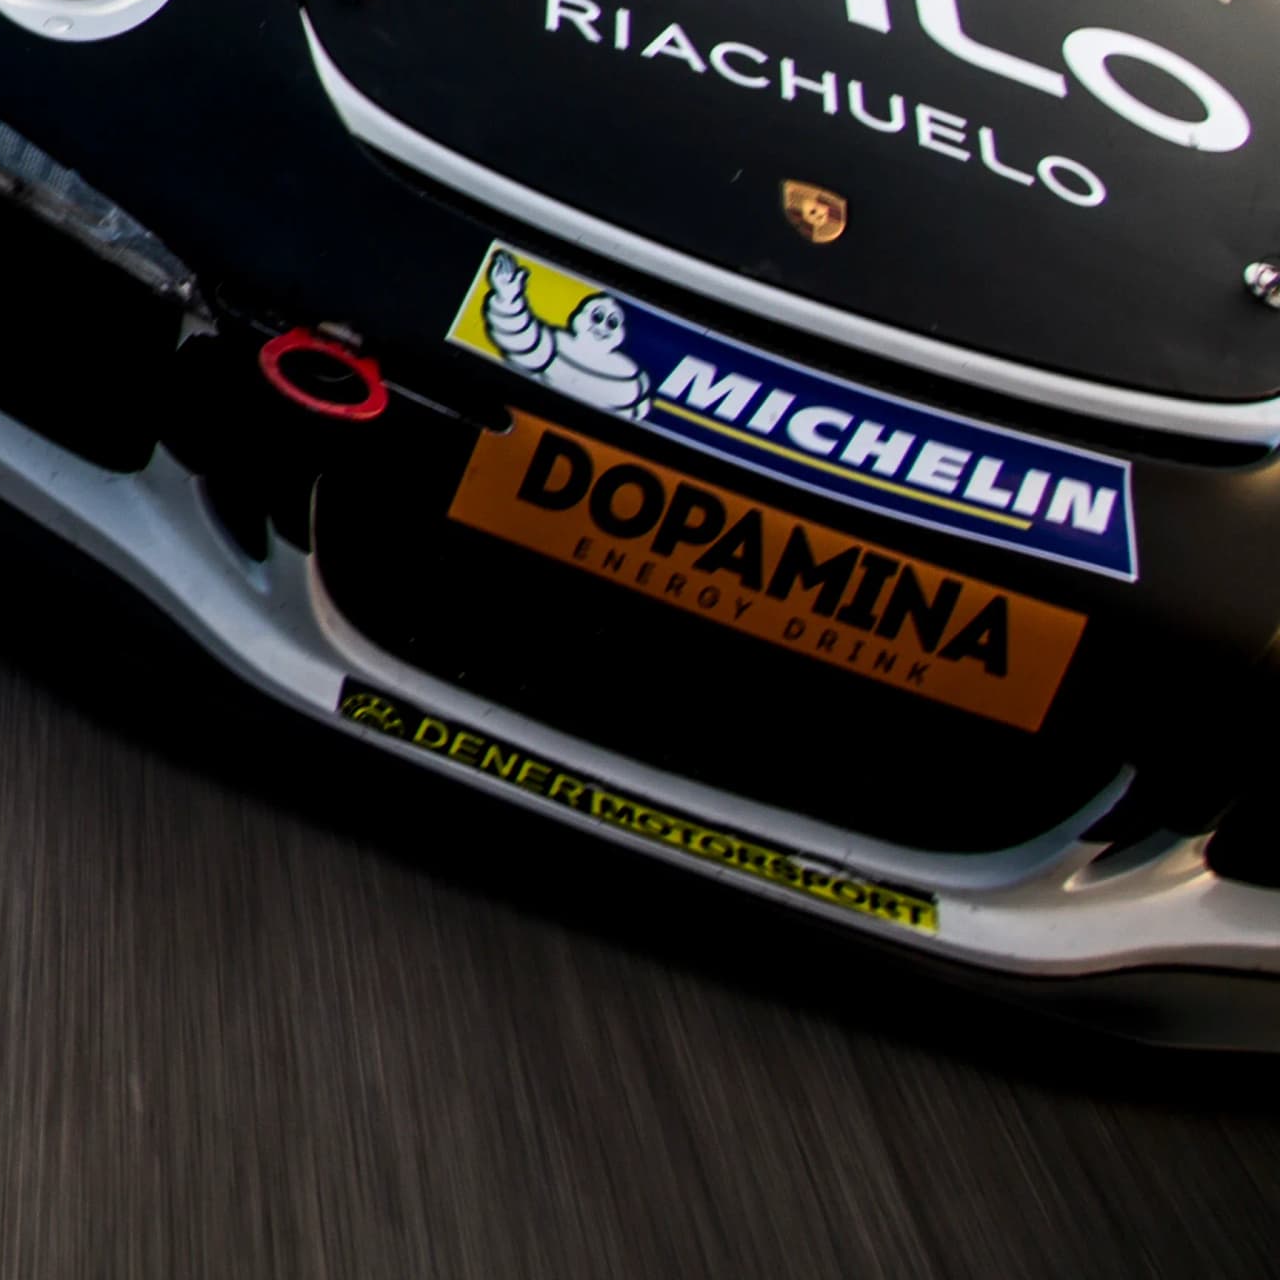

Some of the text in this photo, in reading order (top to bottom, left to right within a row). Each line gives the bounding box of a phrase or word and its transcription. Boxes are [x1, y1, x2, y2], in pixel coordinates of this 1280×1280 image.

[656, 353, 1119, 535] MICHELIN
[513, 429, 1011, 678] DOPAMINA
[572, 536, 931, 686] ENERGY DRINK
